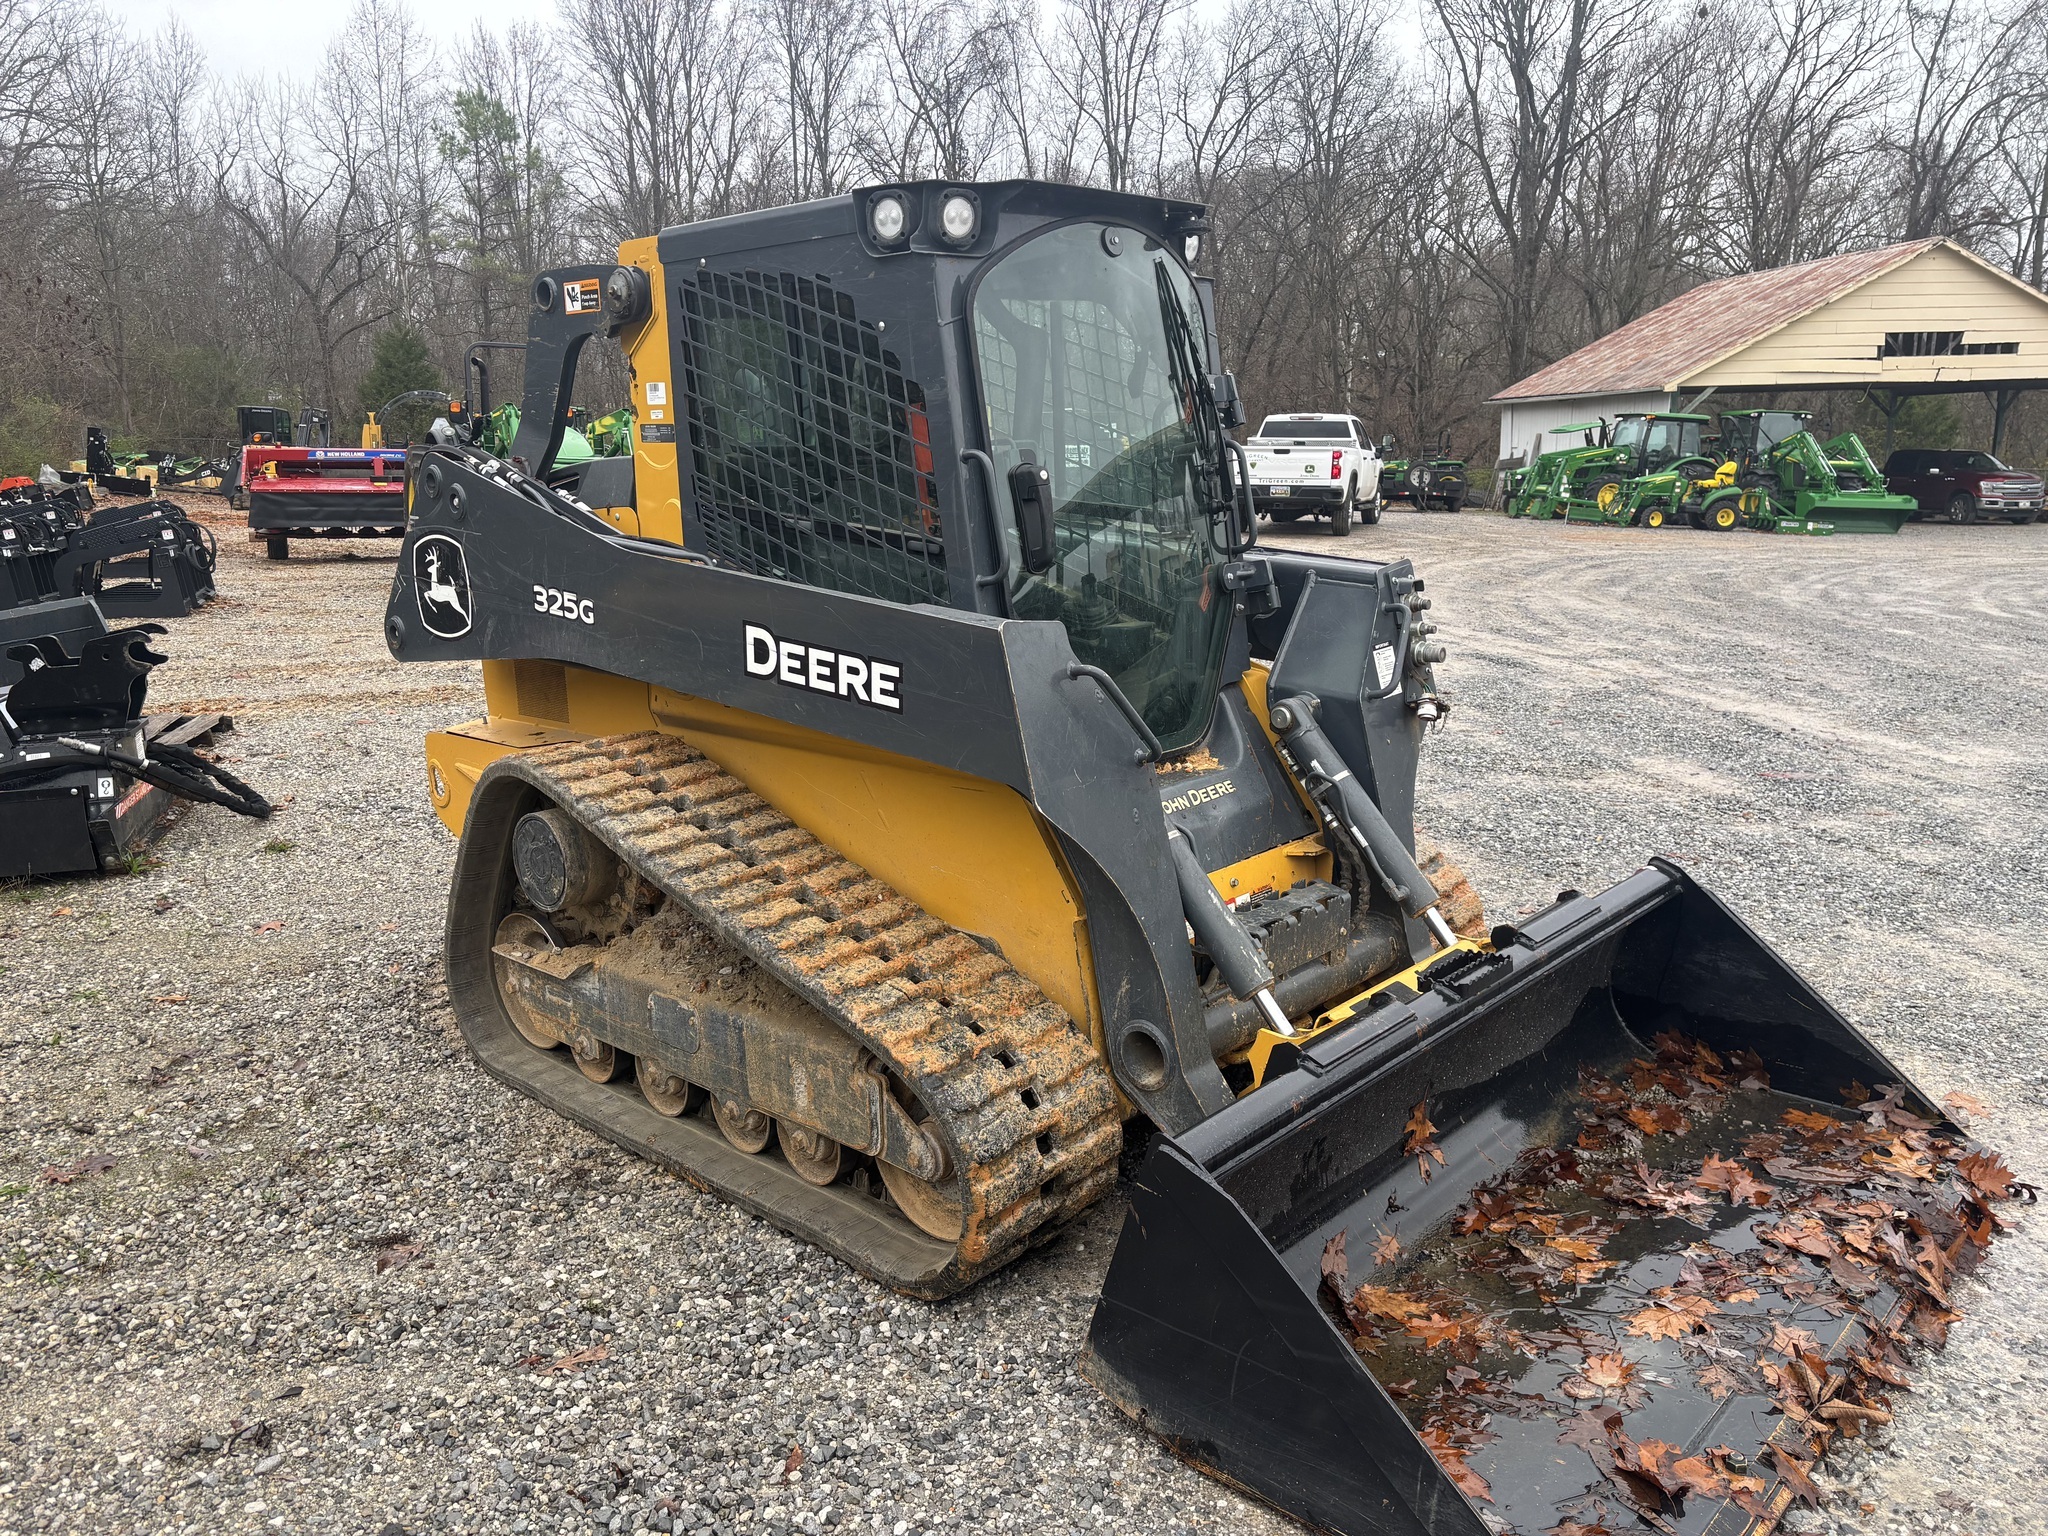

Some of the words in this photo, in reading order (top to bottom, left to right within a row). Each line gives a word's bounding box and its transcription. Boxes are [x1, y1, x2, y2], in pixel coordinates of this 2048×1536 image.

[533, 585, 594, 624] 325G
[744, 624, 900, 709] DEERE
[1161, 795, 1190, 814] OHN
[1187, 780, 1236, 806] DEERE
